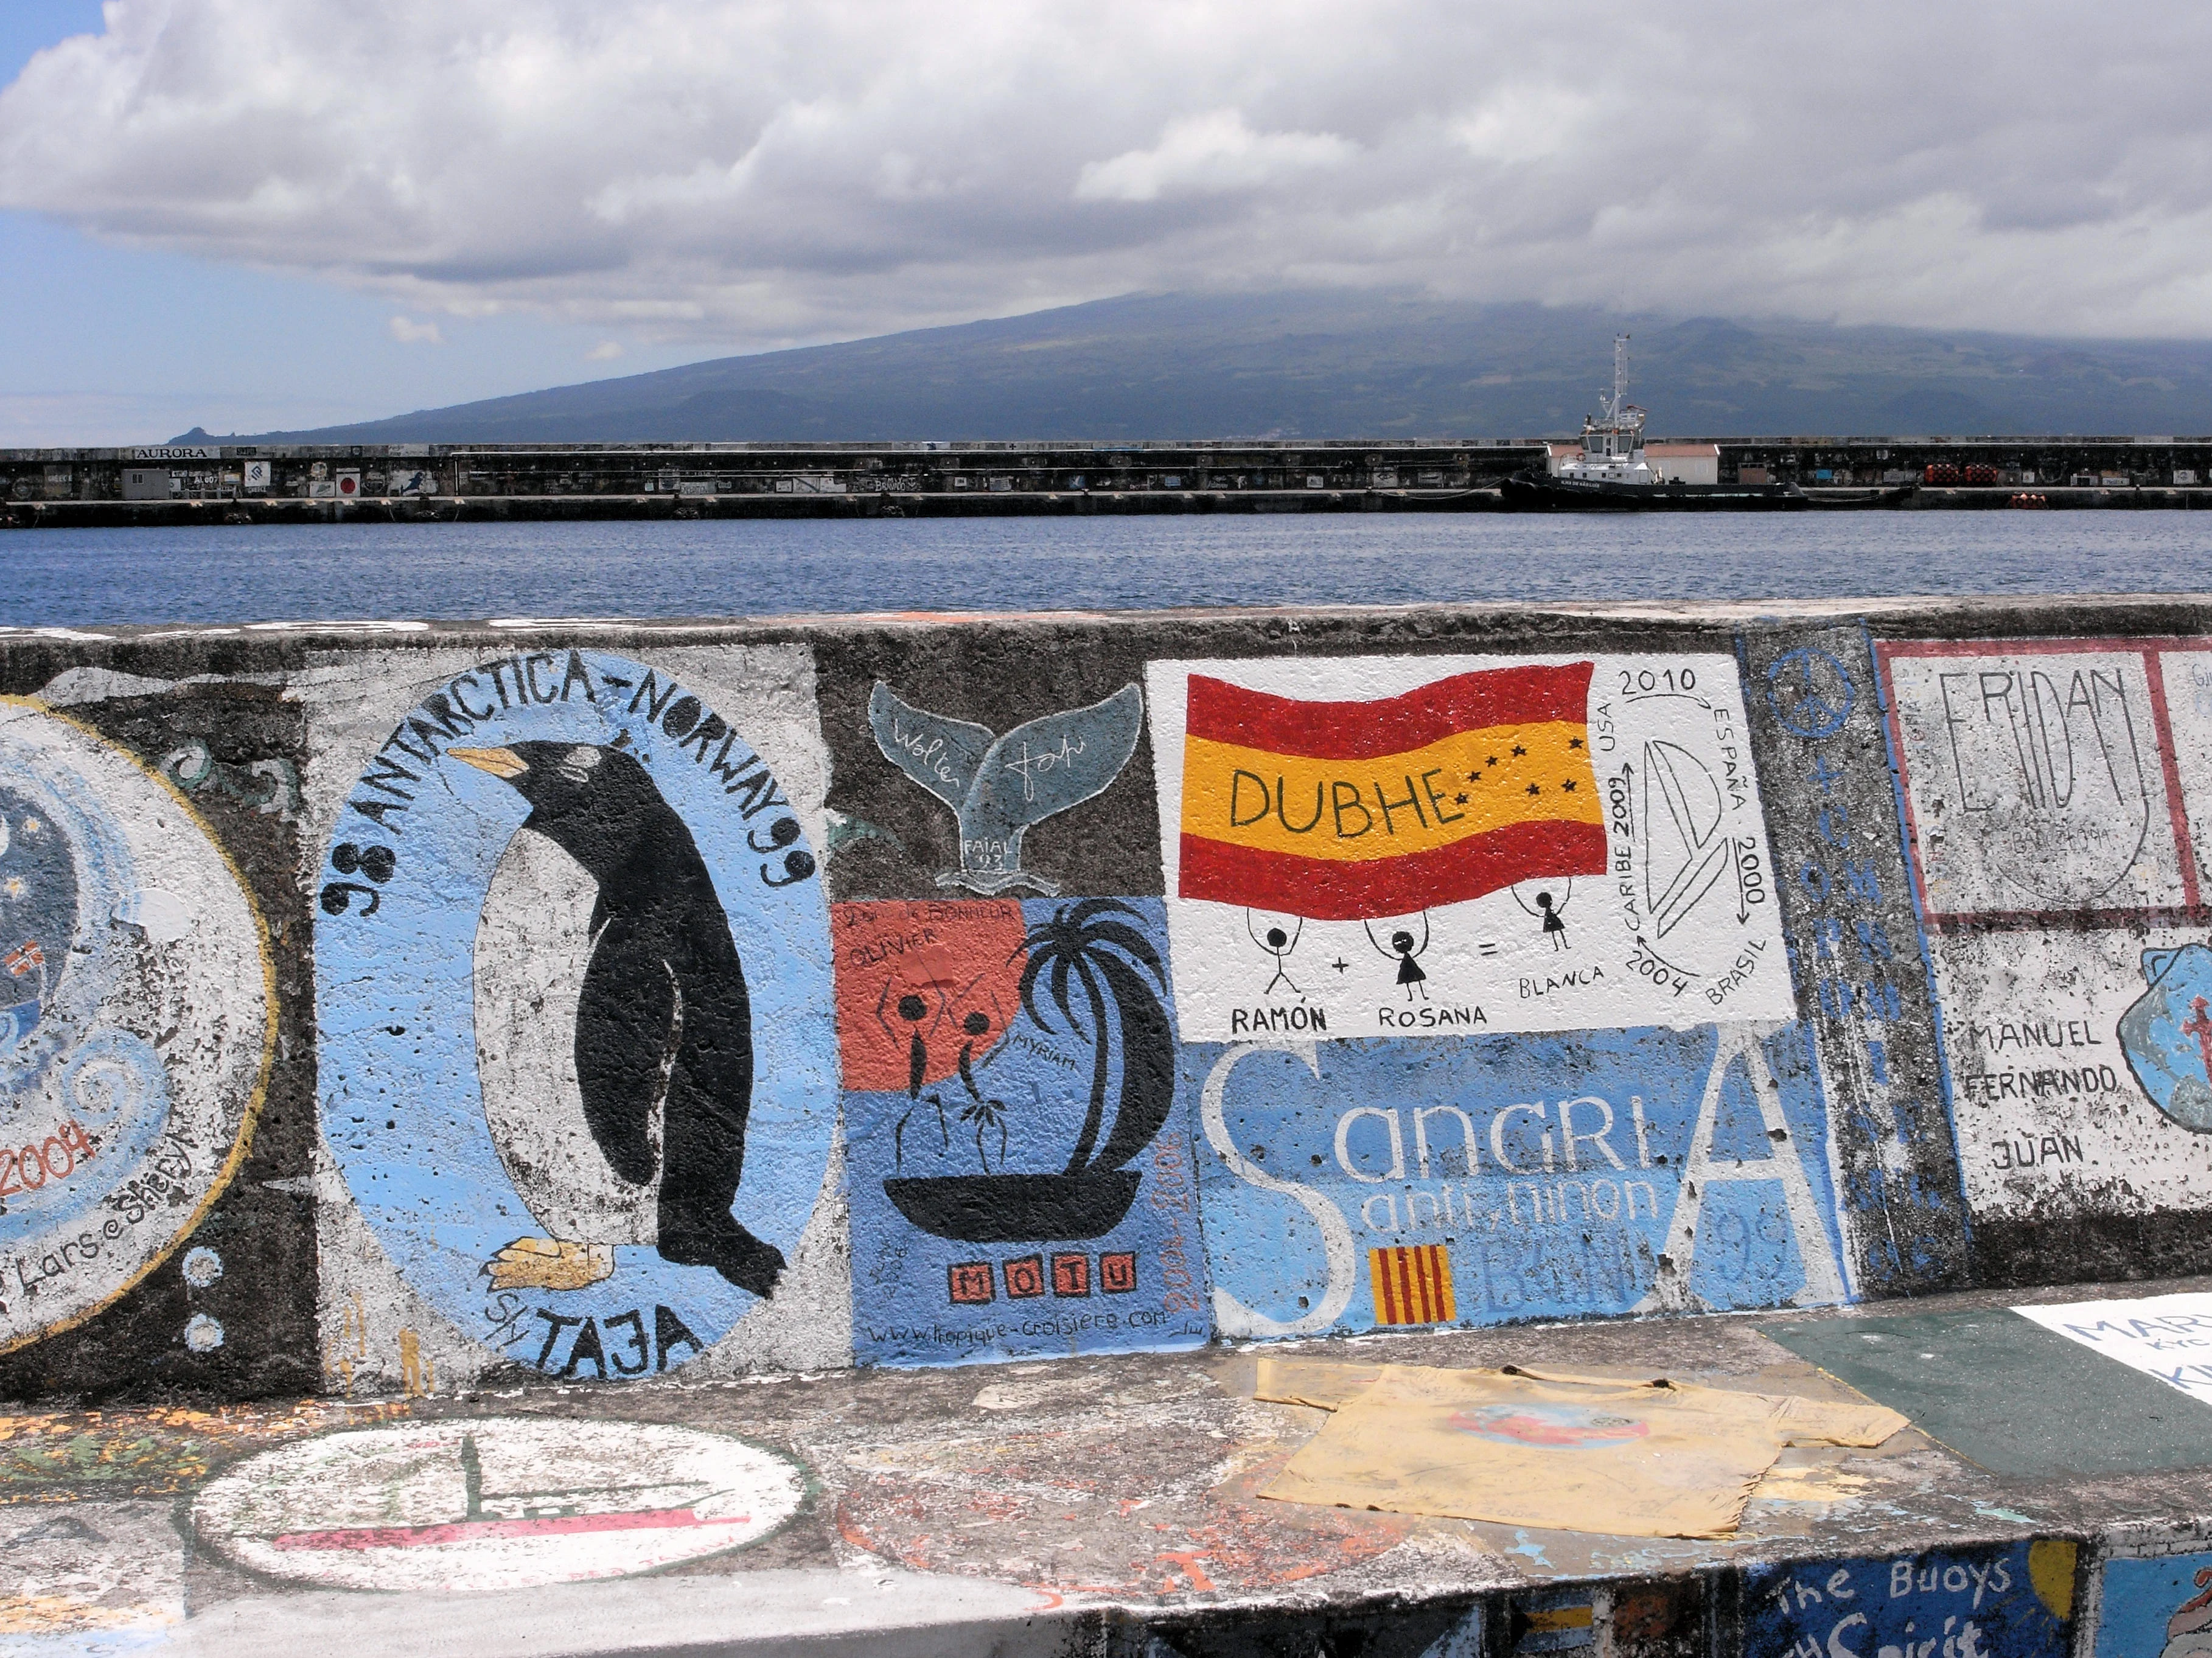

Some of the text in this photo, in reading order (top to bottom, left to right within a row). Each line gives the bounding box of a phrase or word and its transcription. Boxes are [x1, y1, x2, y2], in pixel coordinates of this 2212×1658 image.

[137, 448, 207, 458] AURORA
[1619, 669, 1696, 695] 2010
[1598, 703, 1616, 752] USA
[895, 719, 960, 787] Walter
[1714, 708, 1746, 810] ESPAÑA
[1230, 768, 1465, 839] DUBHE
[320, 842, 396, 916] 98
[747, 817, 815, 887] 99
[1608, 777, 1639, 932] CARIBE 2009
[1738, 837, 1765, 904] 2000
[849, 927, 940, 967] OLIVIER
[1519, 966, 1605, 999] BLANCA
[1627, 949, 1689, 997] 2004
[1705, 939, 1767, 1006] BRASIL
[1231, 998, 1488, 1033] RAMÓN ROSANA
[1968, 1020, 2102, 1050] MANUEL
[1964, 1067, 2118, 1099] FERNANDO
[0, 1119, 96, 1197] 2004
[1991, 1136, 2085, 1169] JUAN
[16, 1230, 99, 1296] Lars
[954, 1258, 1132, 1298] MOTU
[1765, 1557, 2012, 1615] The Buoys
